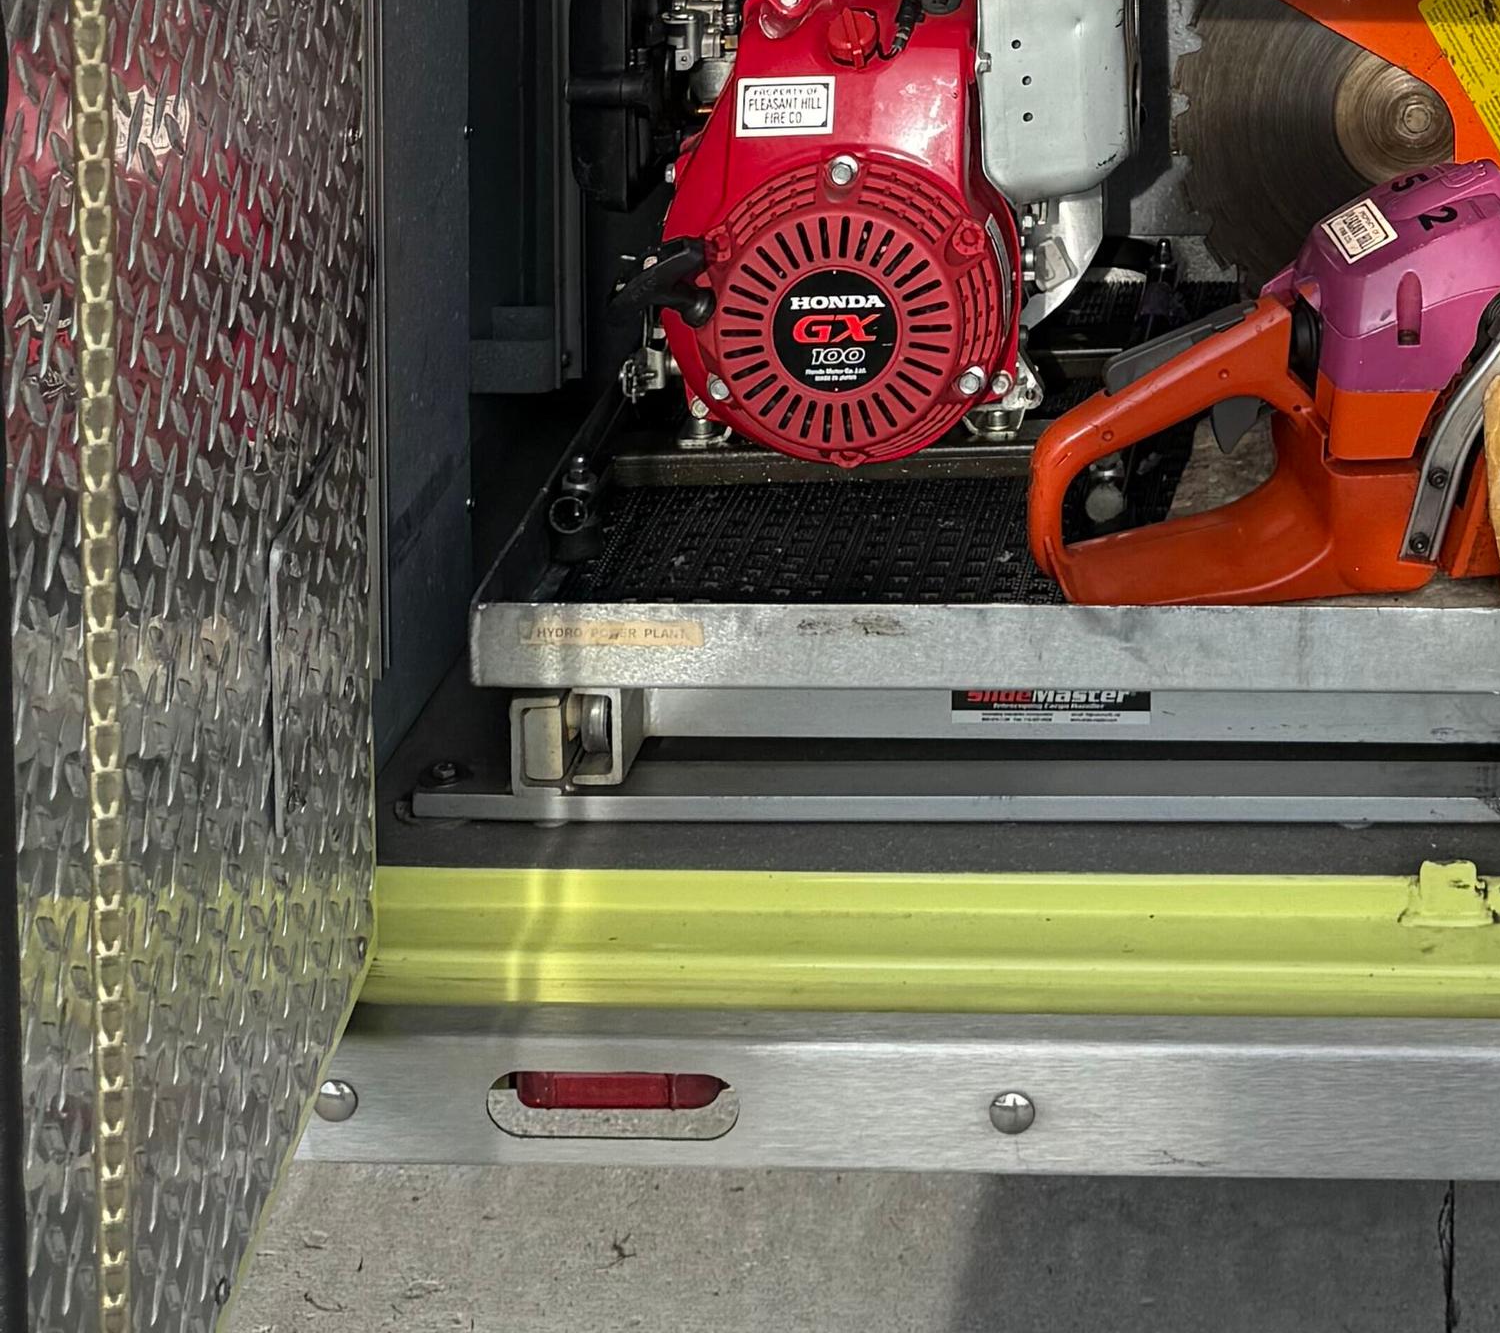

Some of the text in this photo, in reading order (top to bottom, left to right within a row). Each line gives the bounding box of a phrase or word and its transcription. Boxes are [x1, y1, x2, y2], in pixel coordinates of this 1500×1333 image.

[748, 97, 822, 111] PLEASANT HILL
[764, 111, 803, 124] FIRE CO
[1417, 204, 1459, 232] 2
[790, 294, 886, 310] HONDA
[793, 313, 882, 343] GX
[811, 347, 866, 365] 100
[536, 627, 583, 639] HYDRO
